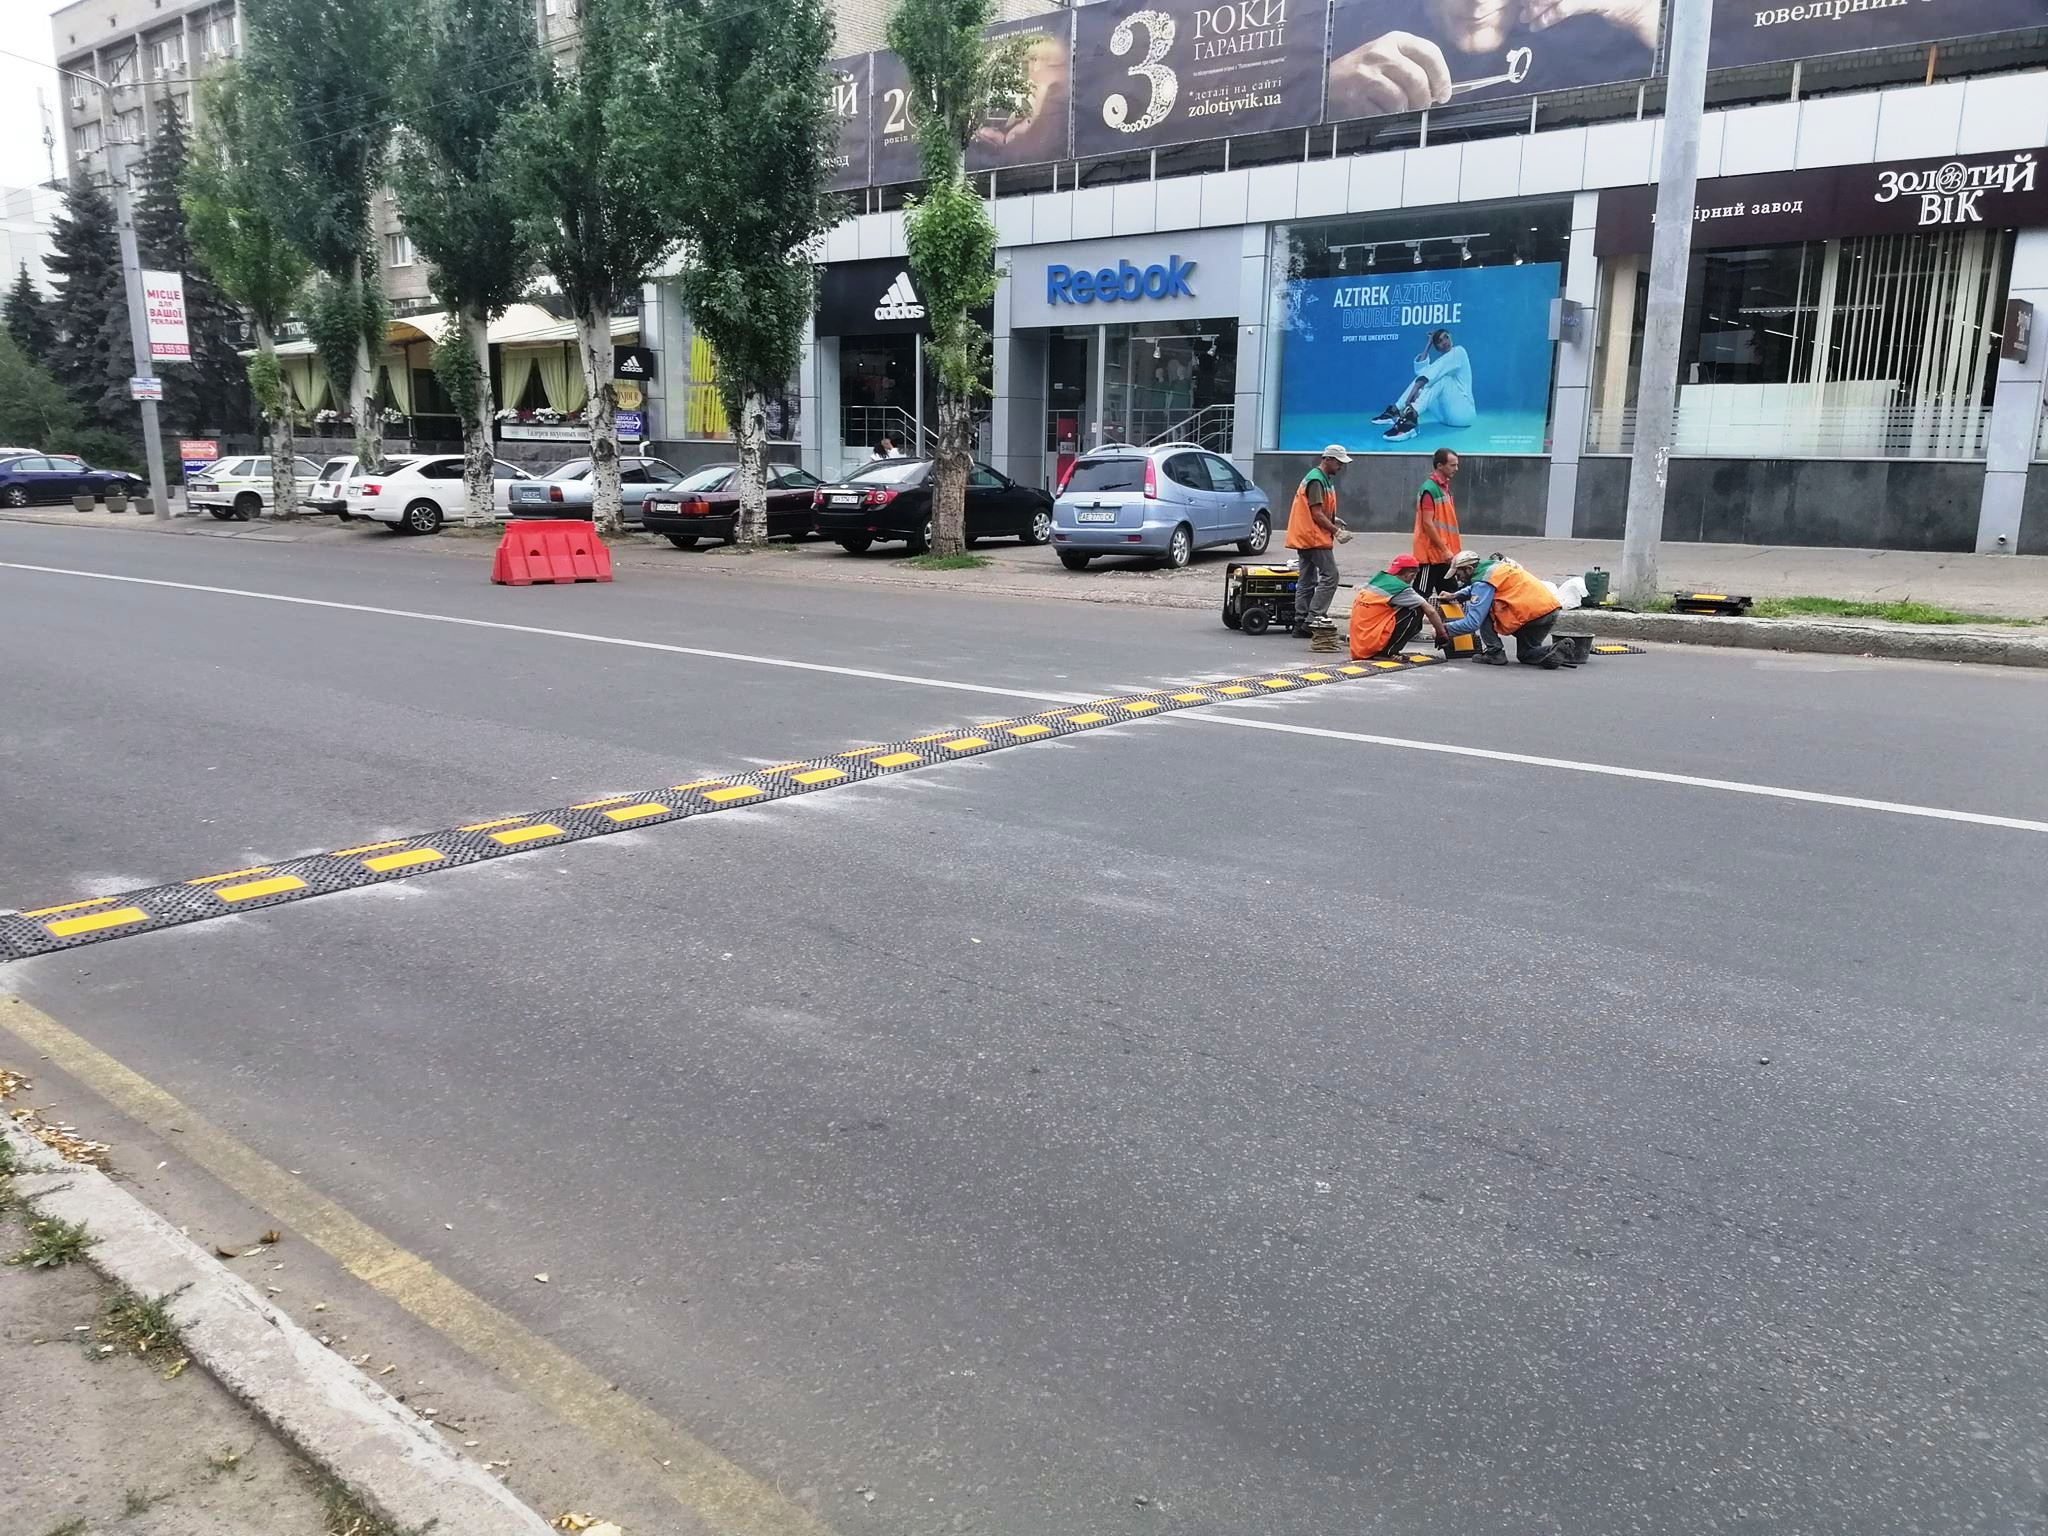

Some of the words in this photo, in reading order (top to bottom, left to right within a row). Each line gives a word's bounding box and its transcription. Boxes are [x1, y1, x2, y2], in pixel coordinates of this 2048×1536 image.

[1193, 0, 1288, 40] РОКИ
[1194, 24, 1285, 61] ГАРАНТІЇ
[1103, 10, 1178, 133] 3
[1234, 85, 1247, 95] на
[1251, 76, 1283, 91] сайті
[1189, 93, 1281, 118] zolotiyvik.ua
[1751, 200, 1804, 215] завод
[1918, 190, 1984, 226] ВІК
[1047, 255, 1197, 305] Reebok
[147, 289, 181, 301] МІСЦЕ
[1333, 285, 1390, 308] AZTREK
[1390, 280, 1452, 305] AZTREK
[149, 307, 182, 318] ВАШОЇ
[874, 303, 926, 321] adidas
[1342, 306, 1401, 329] DOUBLE
[1401, 303, 1462, 326] DOUBLE
[620, 366, 643, 374] adidas
